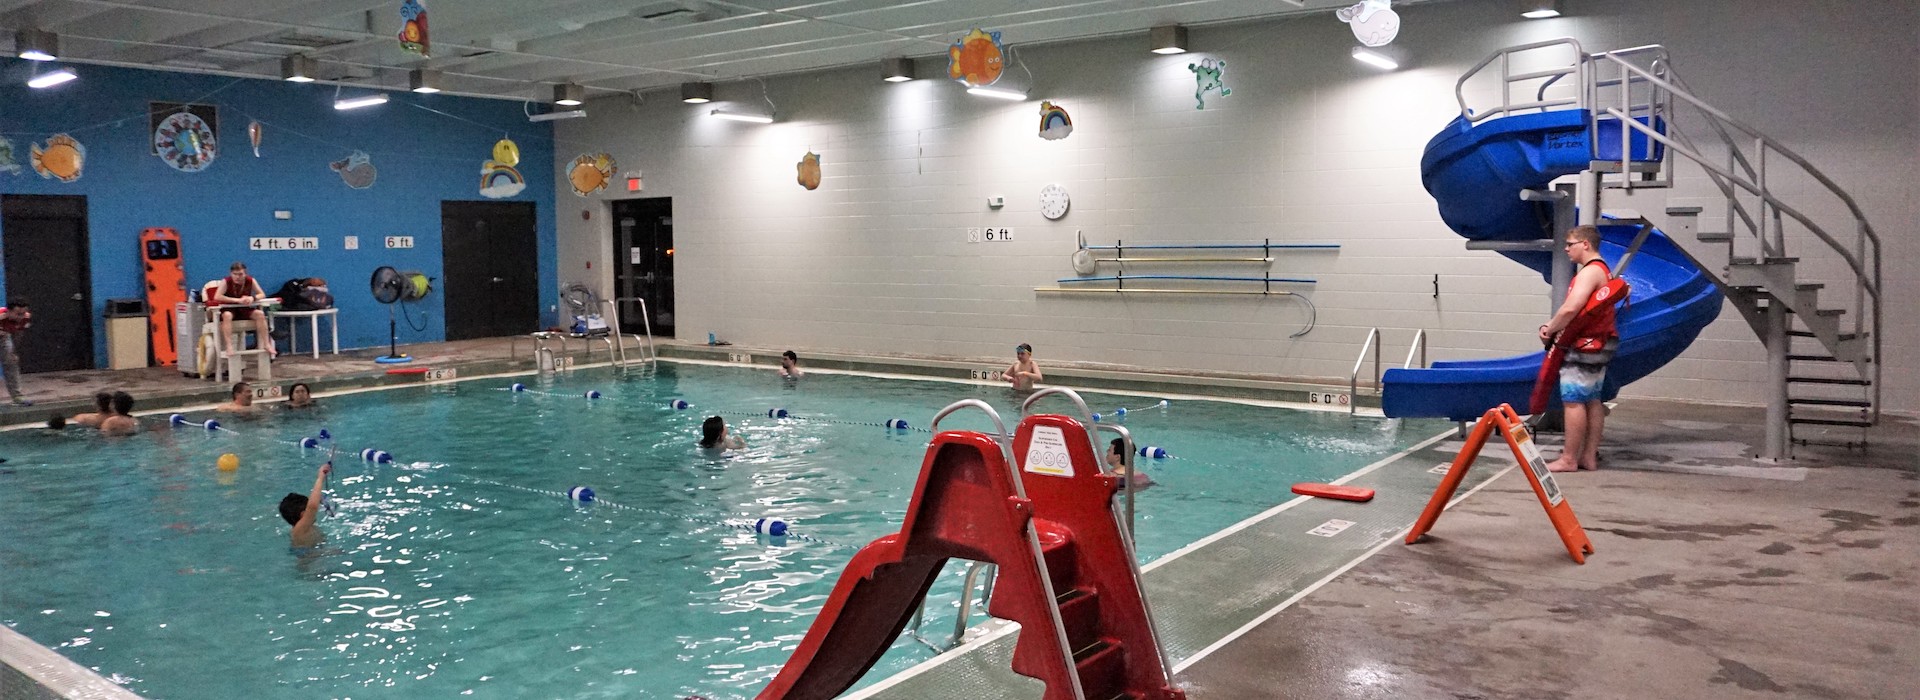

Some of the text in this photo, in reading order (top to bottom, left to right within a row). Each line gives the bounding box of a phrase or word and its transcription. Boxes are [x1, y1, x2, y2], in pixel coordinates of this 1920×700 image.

[986, 228, 1012, 241] 6 ft.
[252, 238, 317, 249] 4 ft. 6 in.
[387, 237, 412, 248] 6 ft.
